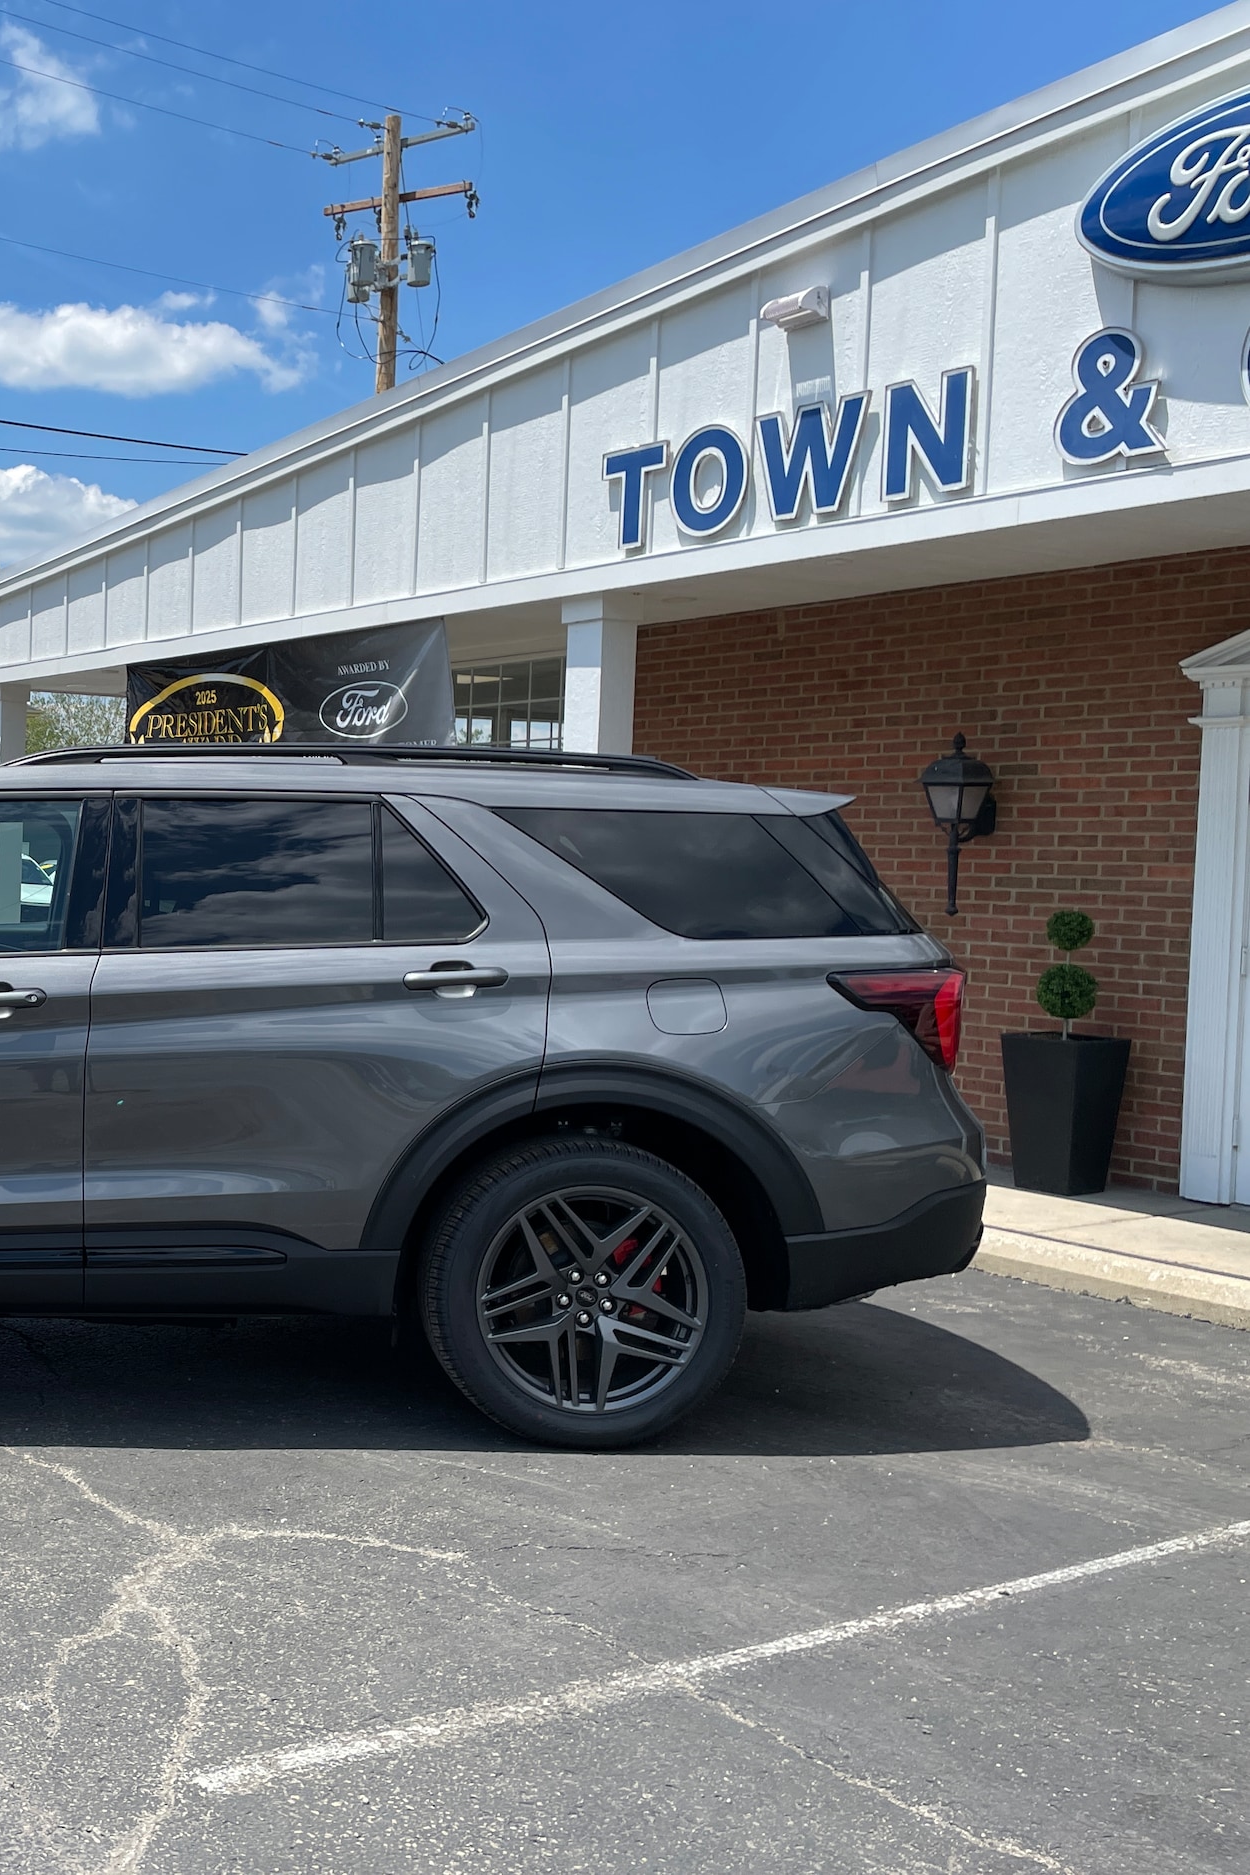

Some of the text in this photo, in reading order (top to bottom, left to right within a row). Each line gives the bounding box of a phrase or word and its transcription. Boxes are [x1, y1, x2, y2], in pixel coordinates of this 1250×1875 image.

[1147, 124, 1250, 242] Fo
[602, 365, 976, 550] TOWN
[1053, 326, 1169, 466] &
[337, 659, 390, 676] AWARDED BY
[195, 689, 217, 706] 2025
[336, 689, 392, 728] Ford
[145, 703, 268, 739] PRESIDENT'S
